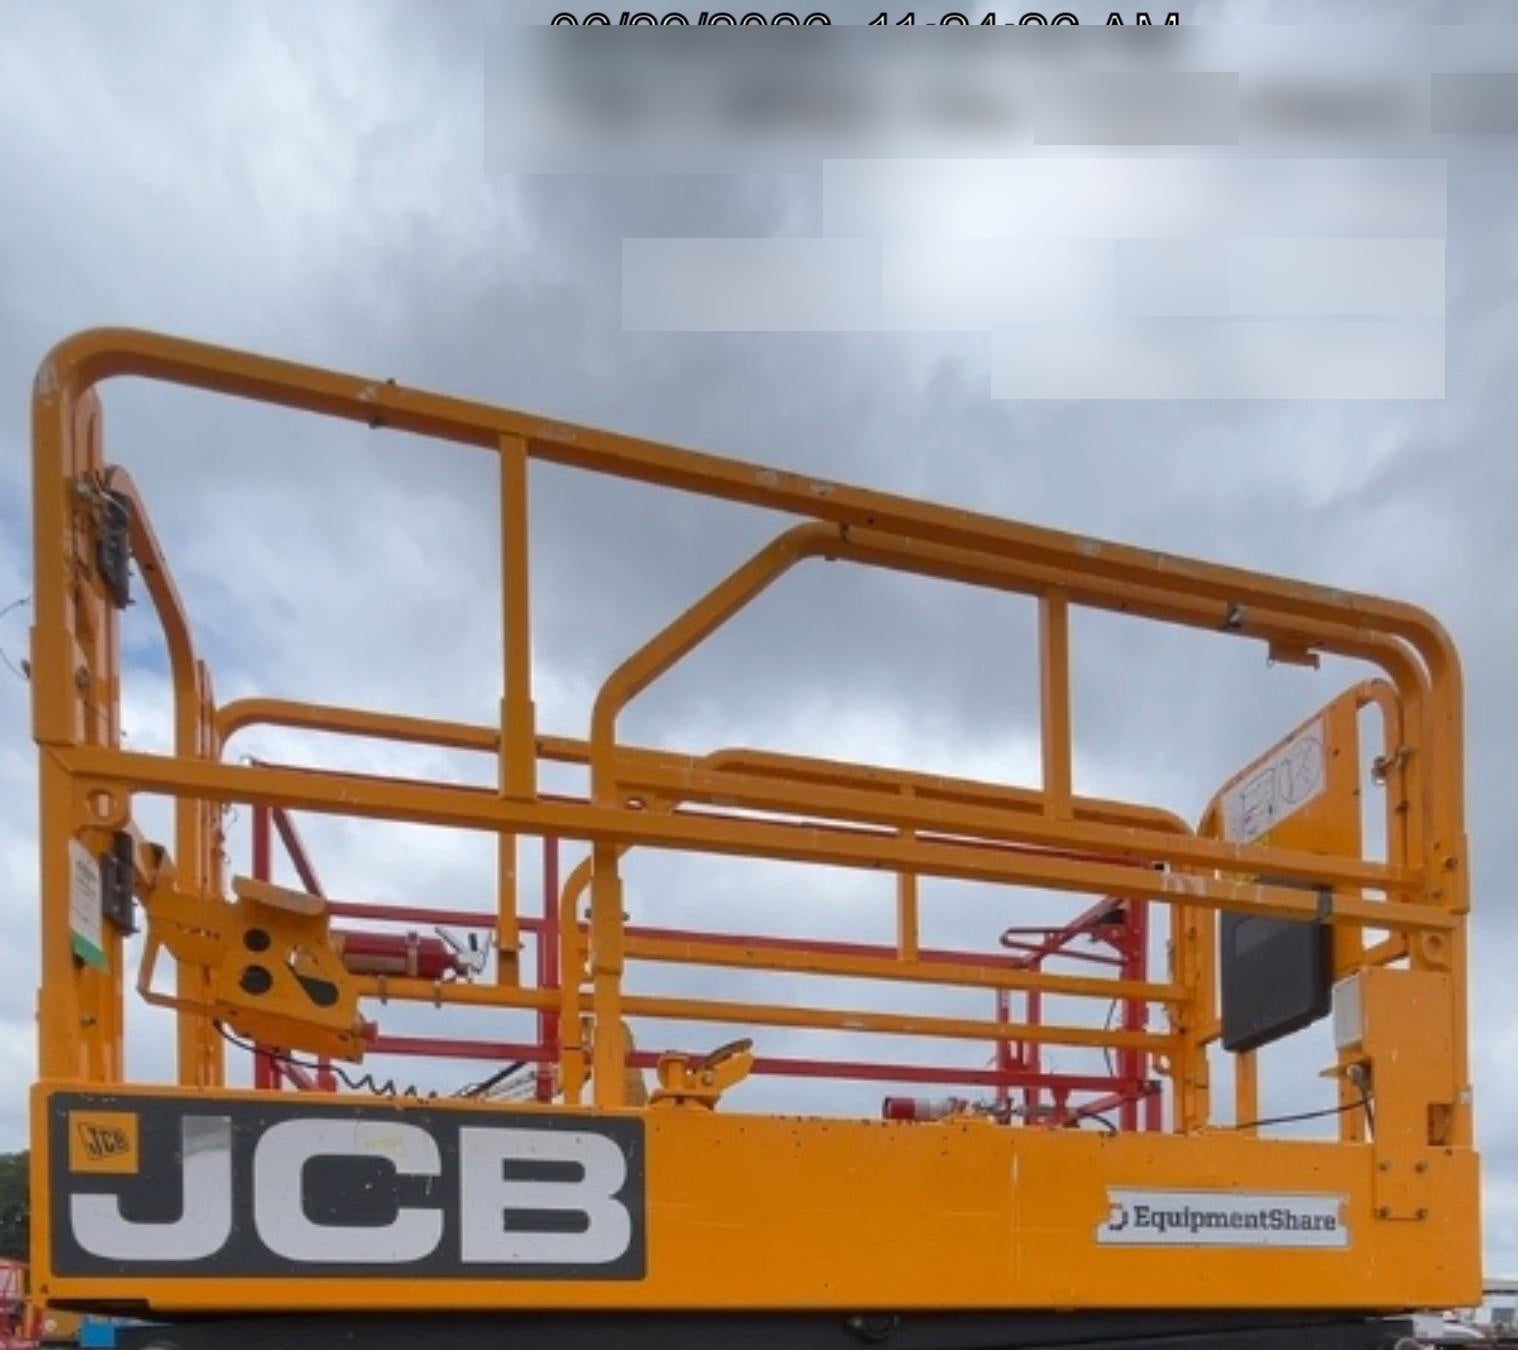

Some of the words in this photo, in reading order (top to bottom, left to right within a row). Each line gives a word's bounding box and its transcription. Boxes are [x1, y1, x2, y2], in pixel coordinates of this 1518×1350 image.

[86, 1126, 130, 1157] JCB
[70, 1115, 632, 1264] JCB
[1133, 1205, 1336, 1233] EquipmentShare
